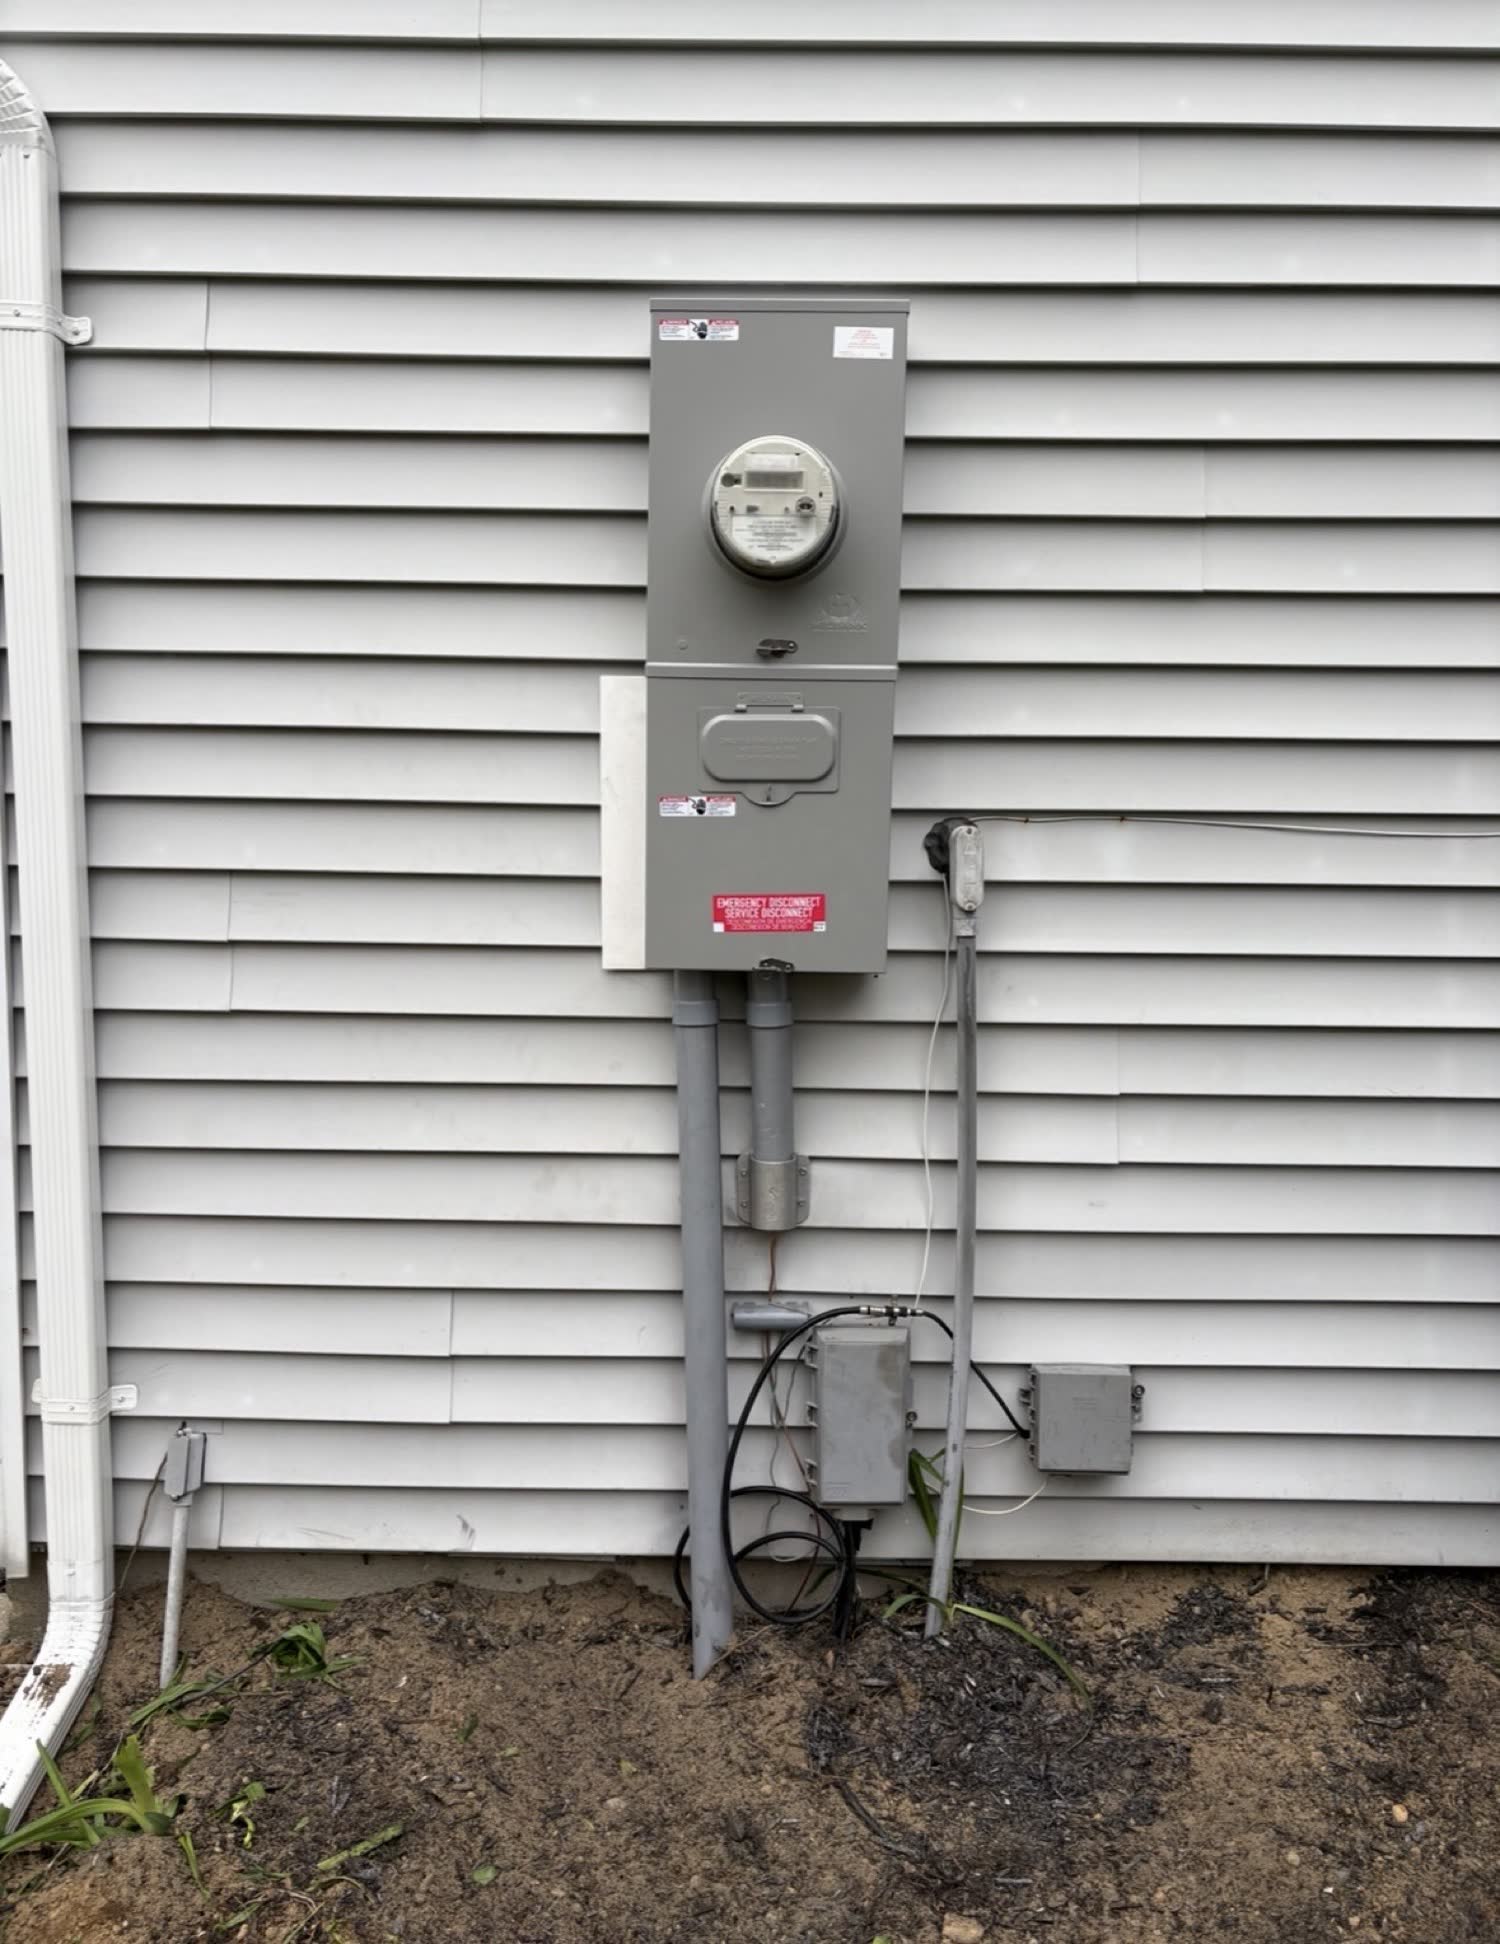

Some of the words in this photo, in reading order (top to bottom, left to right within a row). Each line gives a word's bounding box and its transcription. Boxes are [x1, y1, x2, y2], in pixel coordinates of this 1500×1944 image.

[717, 897, 766, 908] EMERGENCY
[769, 896, 821, 907] DISCONNECT
[725, 908, 759, 918] SERVICE
[761, 907, 813, 918] DISCONNECT
